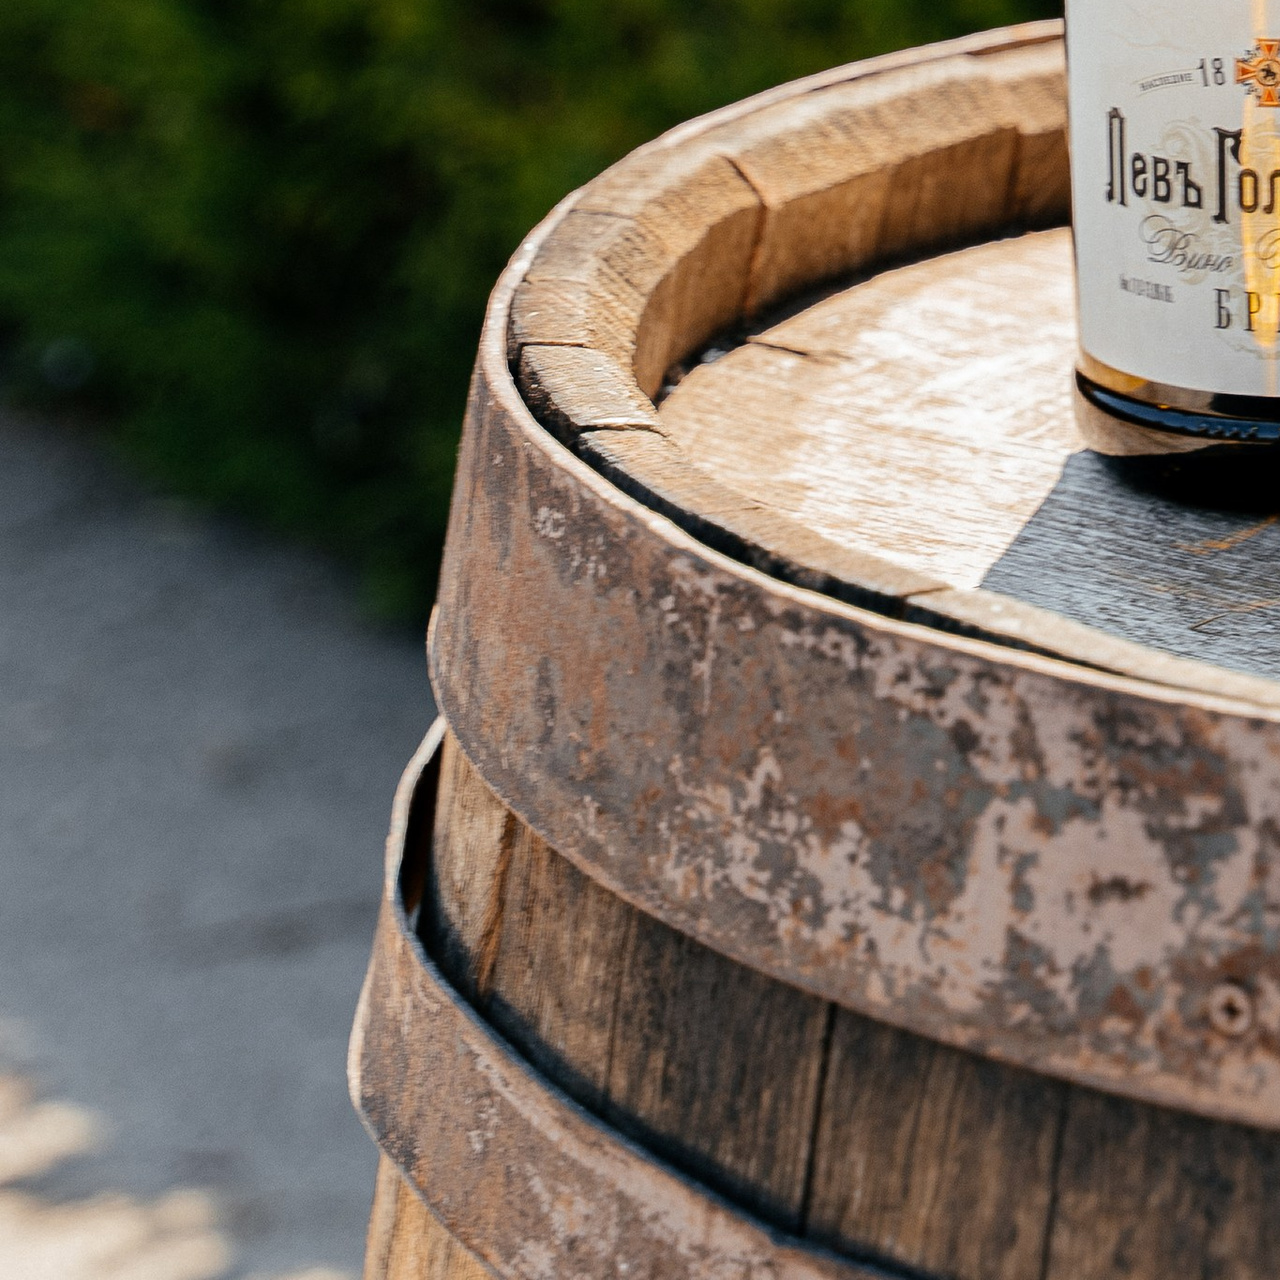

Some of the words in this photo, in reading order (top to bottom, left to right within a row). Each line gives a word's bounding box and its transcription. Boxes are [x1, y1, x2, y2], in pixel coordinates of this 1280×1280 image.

[1197, 58, 1226, 87] 18
[1106, 106, 1203, 207] Левъ
[1138, 214, 1234, 273] Вино
